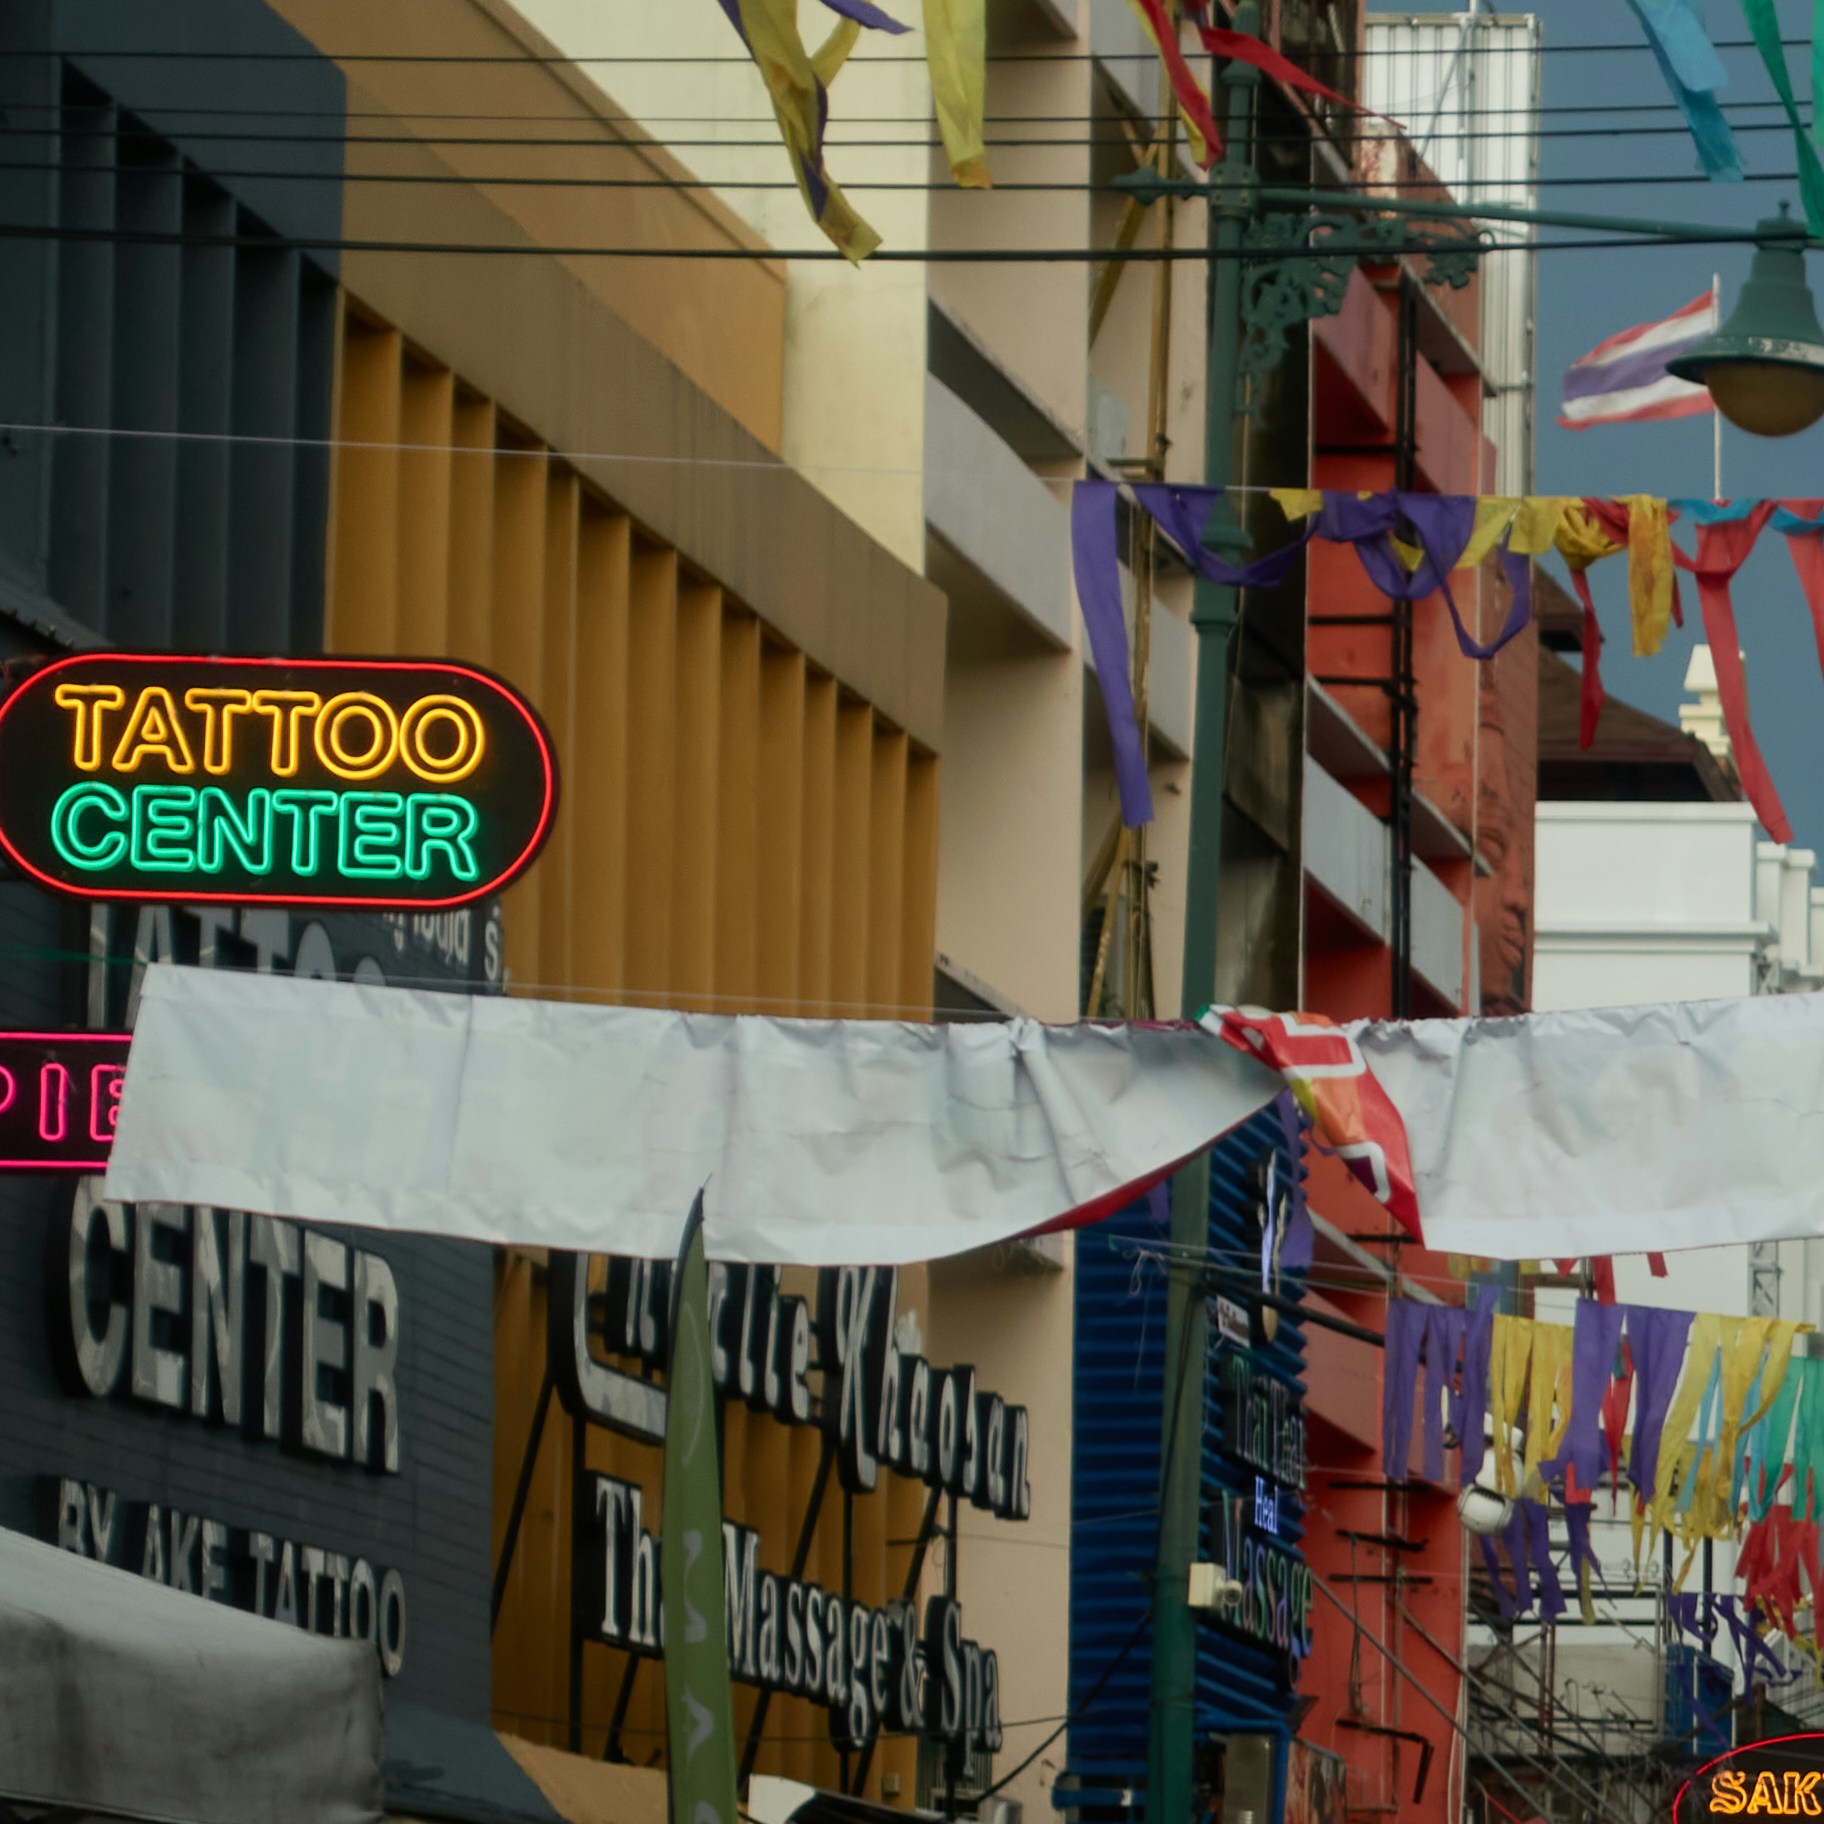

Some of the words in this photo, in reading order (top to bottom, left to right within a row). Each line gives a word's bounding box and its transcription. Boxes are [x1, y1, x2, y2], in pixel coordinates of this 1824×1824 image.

[54, 683, 487, 783] TATTOO
[50, 781, 480, 882] CENTER
[70, 1175, 400, 1473] CENTER
[59, 1477, 116, 1563] BY
[141, 1503, 229, 1600] AKE
[251, 1531, 406, 1678] TATTOO
[1253, 1474, 1280, 1536] Heal
[722, 1521, 890, 1749] Massage
[900, 1604, 928, 1728] &
[941, 1601, 1001, 1777] Spa
